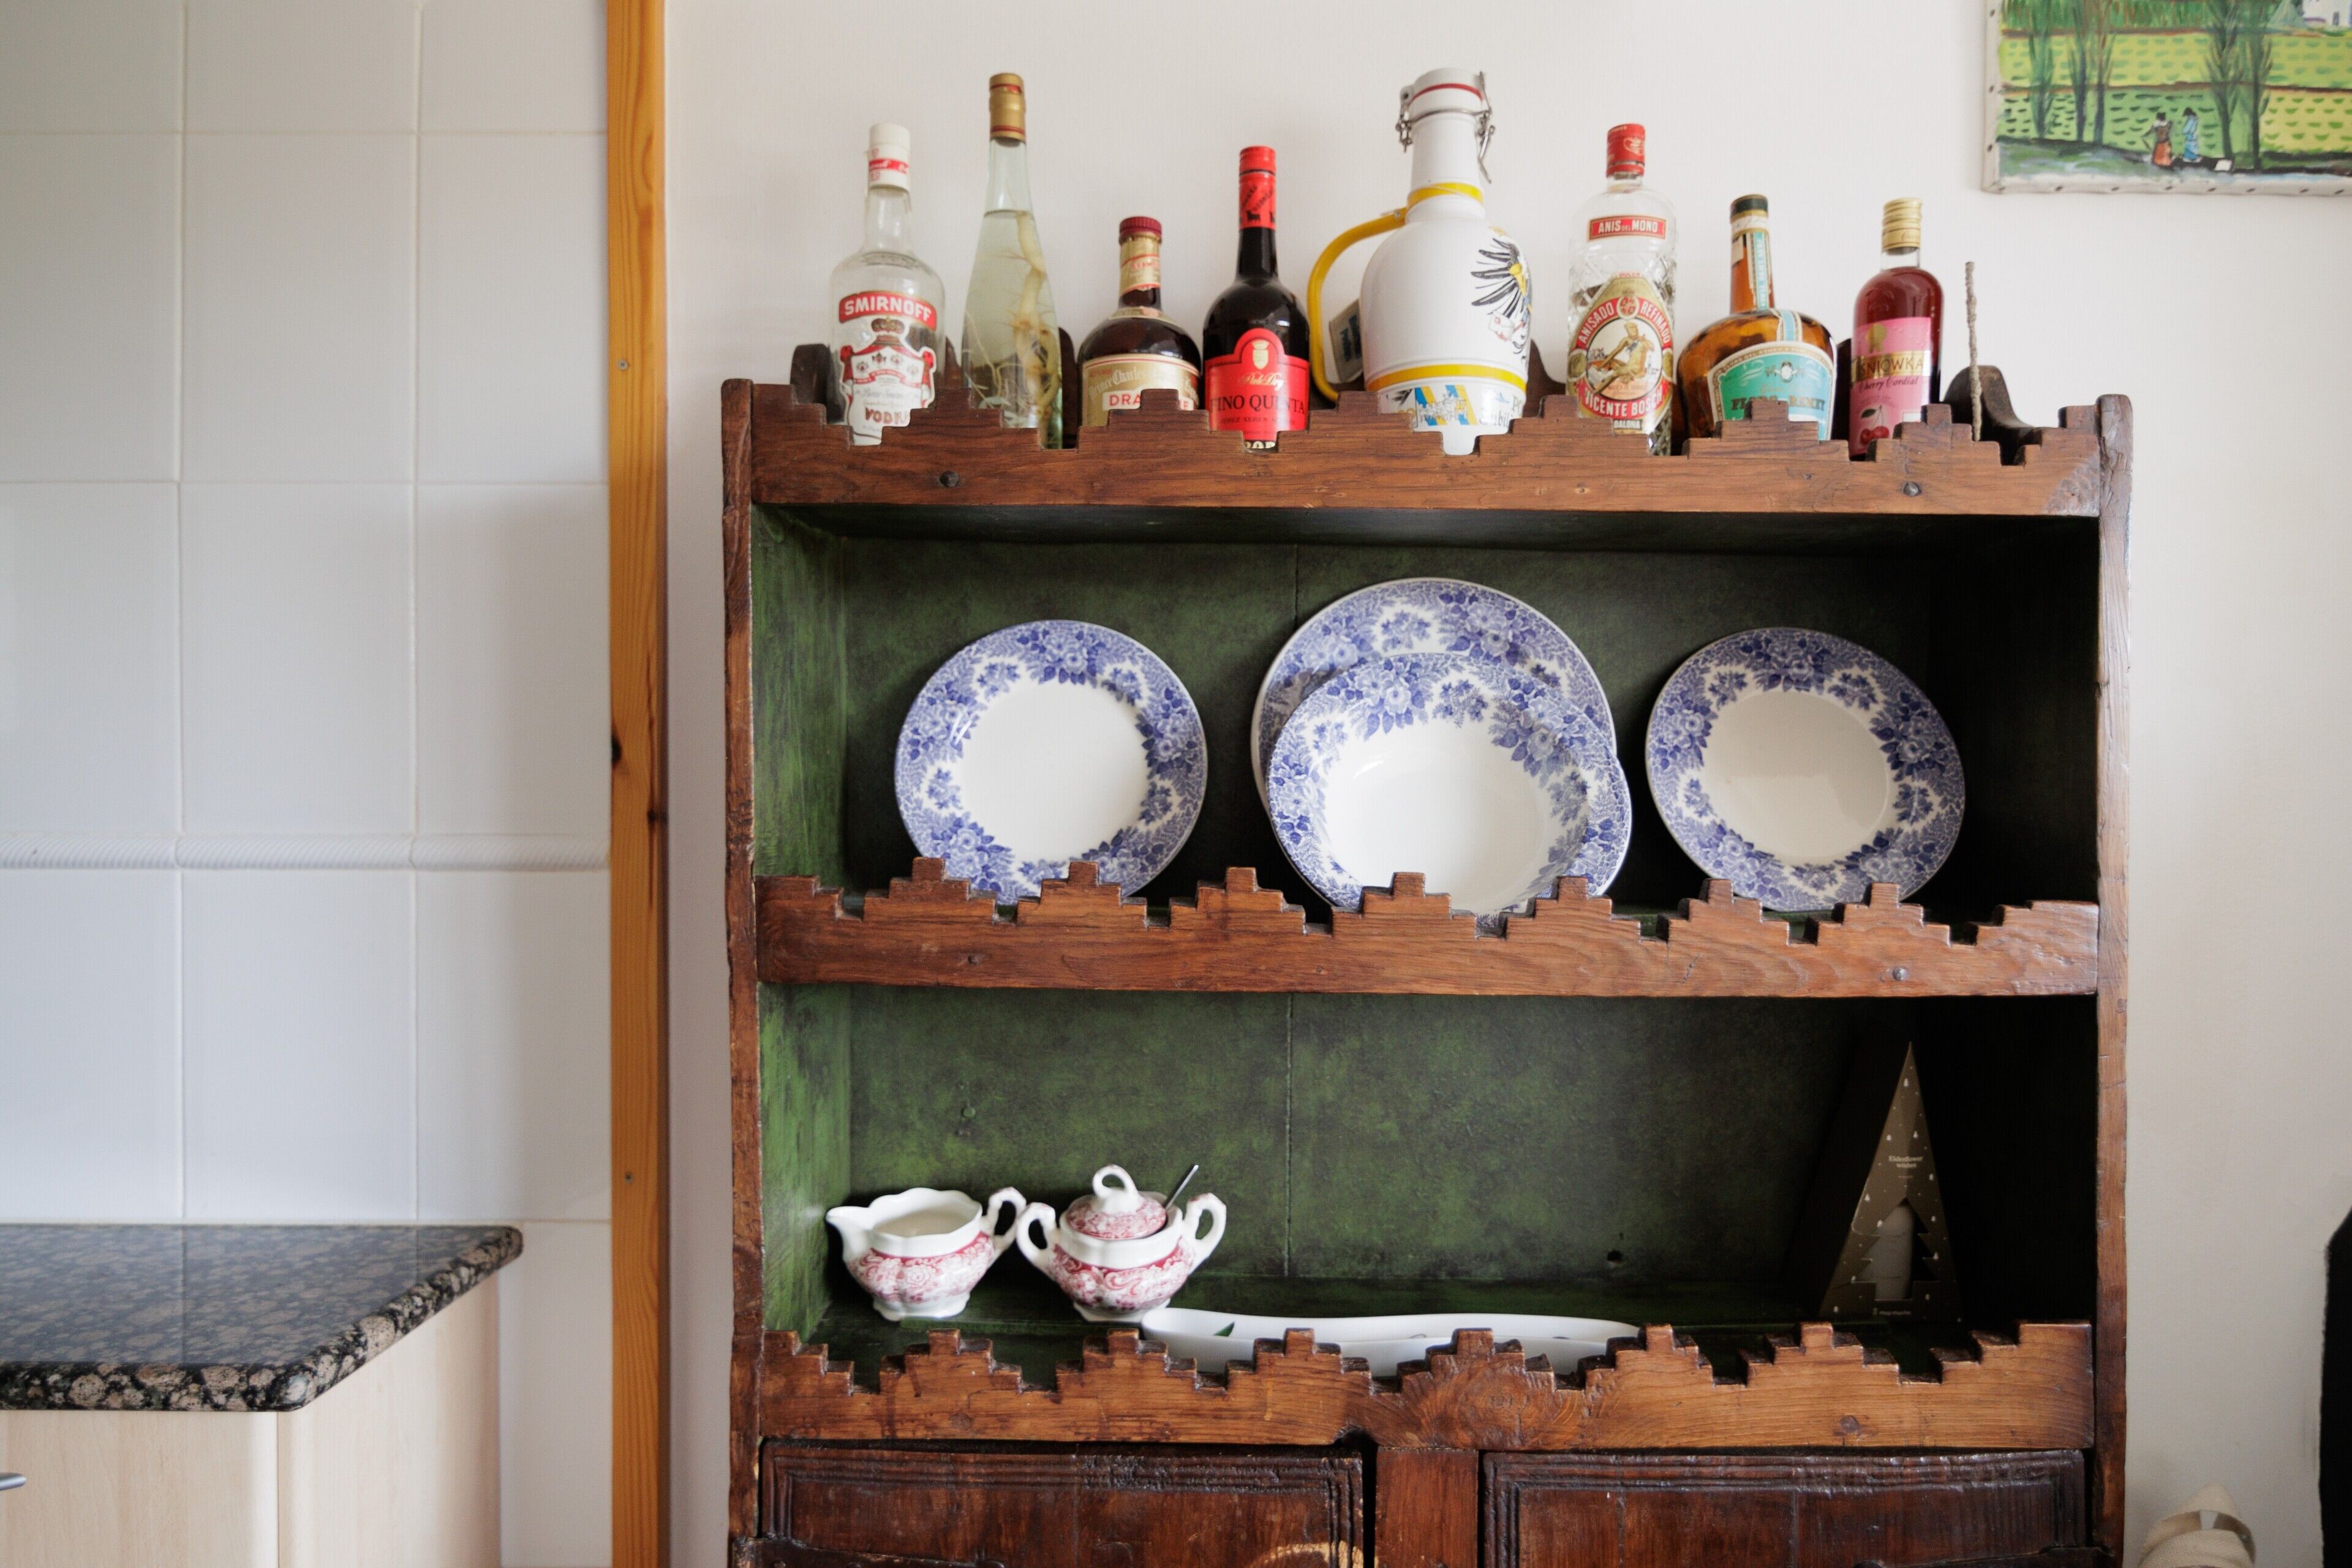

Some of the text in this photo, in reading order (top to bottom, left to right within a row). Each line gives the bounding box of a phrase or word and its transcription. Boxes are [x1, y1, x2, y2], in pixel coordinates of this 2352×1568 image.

[1598, 220, 1621, 234] ANIS
[1631, 219, 1658, 233] MONO
[845, 295, 932, 322] SMIRNOFF
[1578, 301, 1615, 344] ANISADO
[1640, 301, 1672, 345] REFINADO
[1887, 375, 1919, 388] Cordial
[1585, 387, 1627, 417] VICENTE
[1631, 385, 1663, 415] BOSCH
